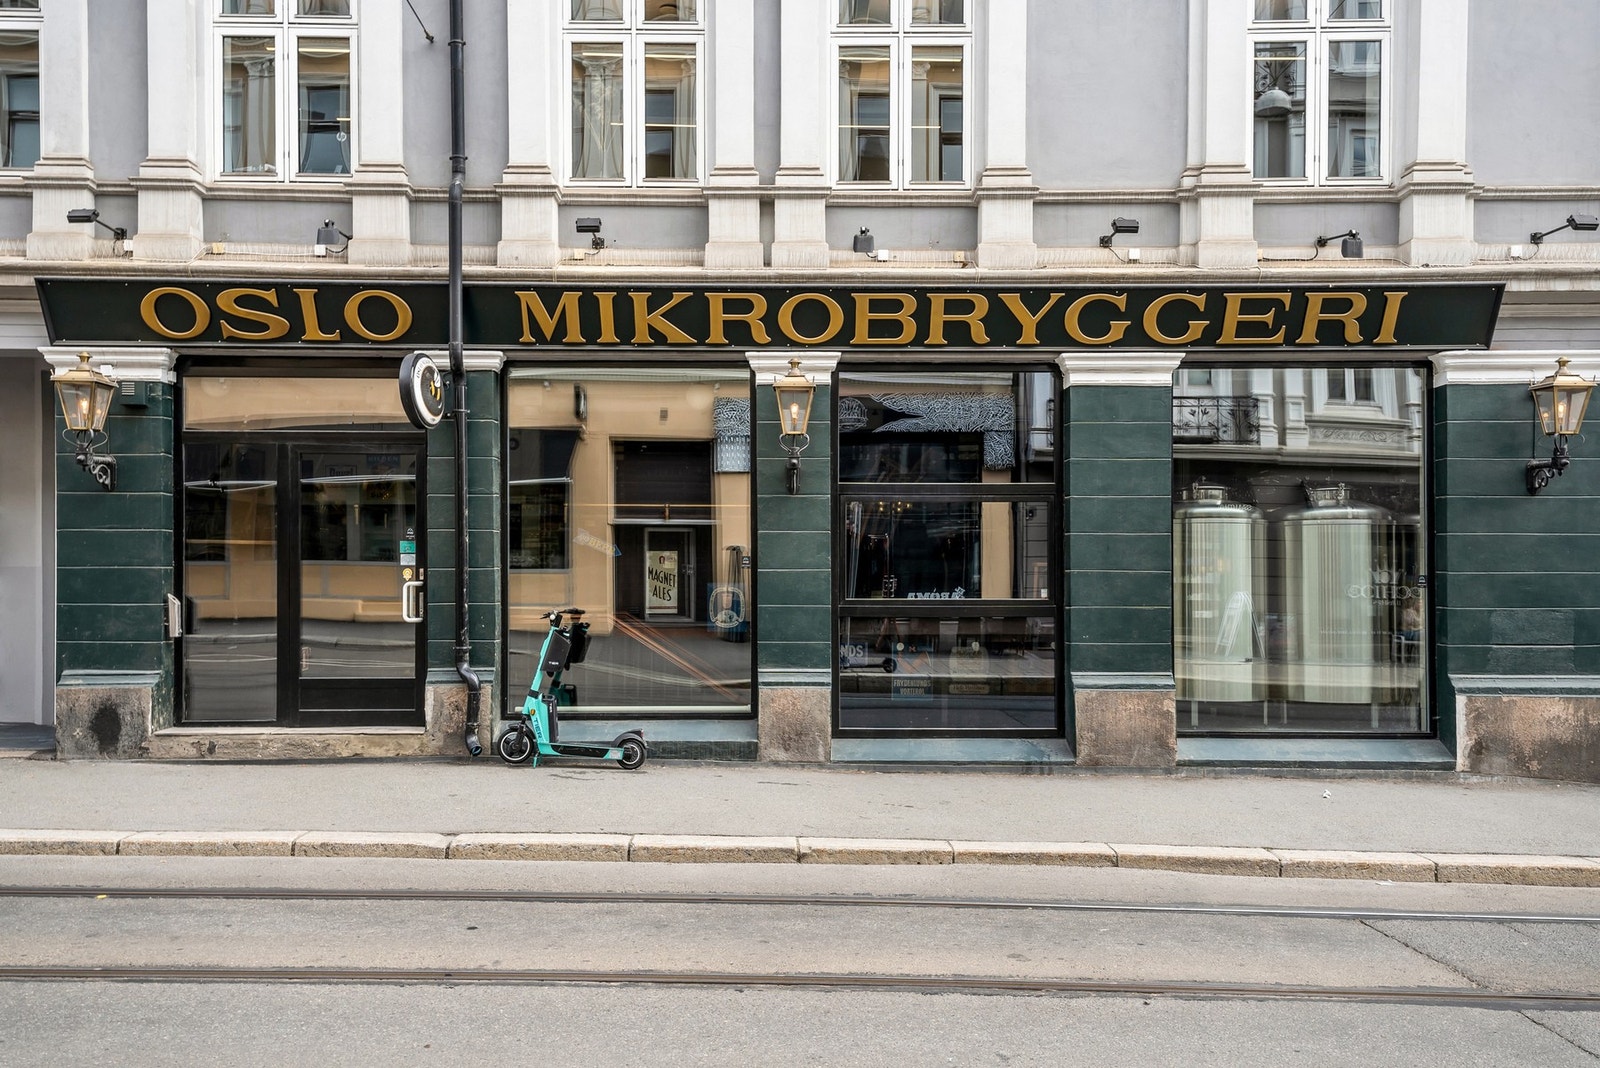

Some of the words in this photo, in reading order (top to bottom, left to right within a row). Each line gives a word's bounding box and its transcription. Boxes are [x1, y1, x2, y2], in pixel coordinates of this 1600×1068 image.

[139, 286, 413, 341] OSLO
[514, 290, 1409, 346] MIKROBRYGGERI
[648, 566, 676, 588] MAGNET
[652, 585, 672, 602] ALES
[533, 717, 543, 740] TIER
